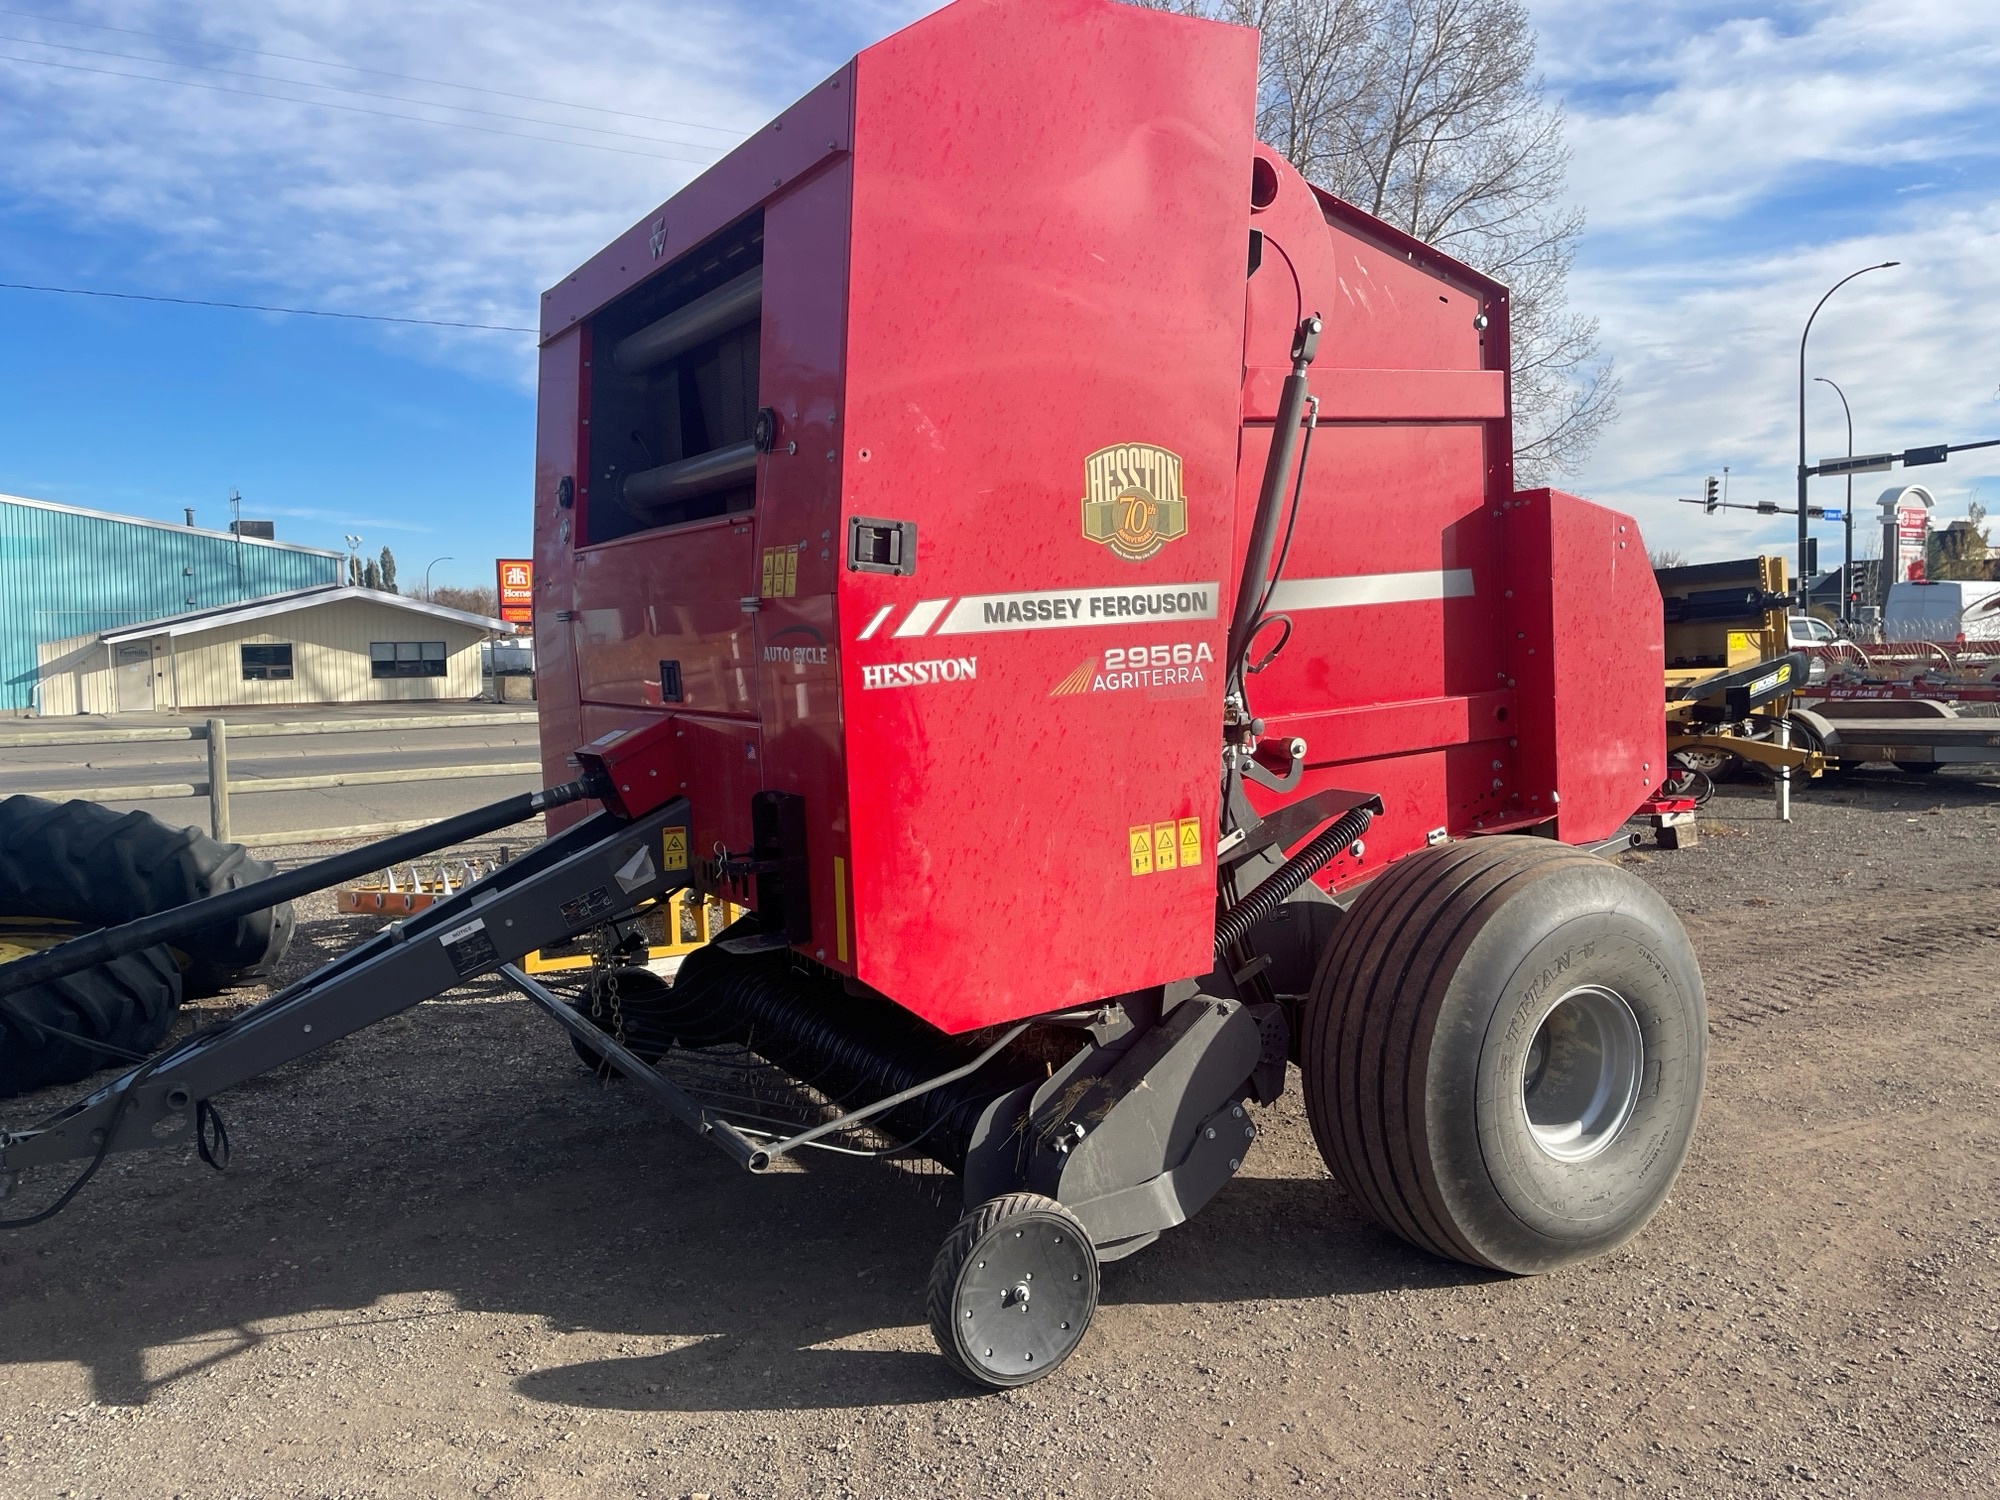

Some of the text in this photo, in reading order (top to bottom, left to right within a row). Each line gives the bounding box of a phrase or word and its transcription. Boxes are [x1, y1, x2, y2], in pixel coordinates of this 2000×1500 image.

[1089, 448, 1179, 503] HESSTON
[1120, 496, 1156, 534] 70th
[1118, 529, 1154, 544] ANNIVERSARY
[503, 588, 532, 598] Home
[983, 591, 1208, 624] MASSEY FERGUSON
[763, 646, 828, 664] AUTO CYCLE
[1105, 642, 1214, 670] 2956A
[862, 657, 978, 690] HESSTON
[1092, 665, 1204, 691] AGRITERRA
[1830, 690, 1853, 698] EASY
[1855, 690, 1879, 698] RAKE
[452, 925, 473, 938] NOTICE
[1505, 947, 1575, 1045] TITAN
